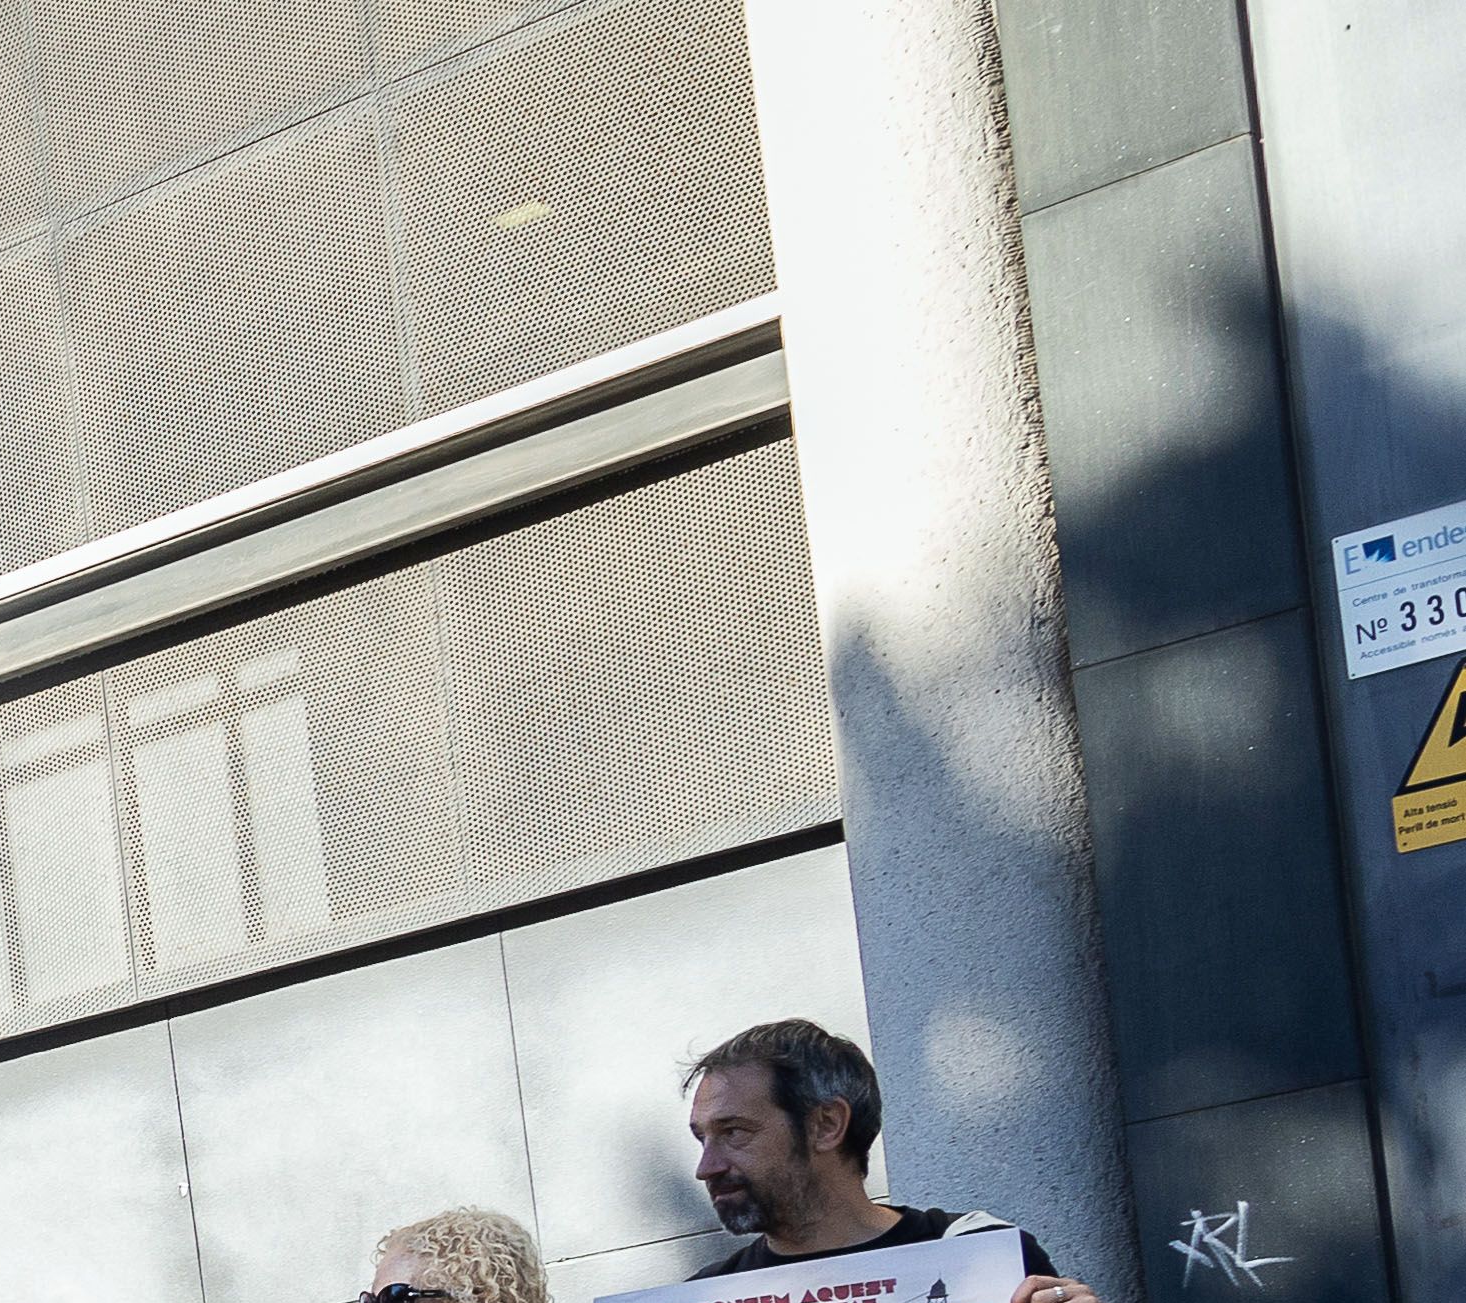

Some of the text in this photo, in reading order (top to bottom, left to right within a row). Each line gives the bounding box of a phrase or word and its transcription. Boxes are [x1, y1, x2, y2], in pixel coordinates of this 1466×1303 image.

[1402, 525, 1466, 558] ende
[1352, 592, 1388, 608] Centre
[1393, 586, 1407, 597] de
[1359, 638, 1417, 660] Accessible
[1403, 807, 1424, 818] Alta
[1398, 822, 1423, 835] Perill
[1425, 820, 1439, 829] de
